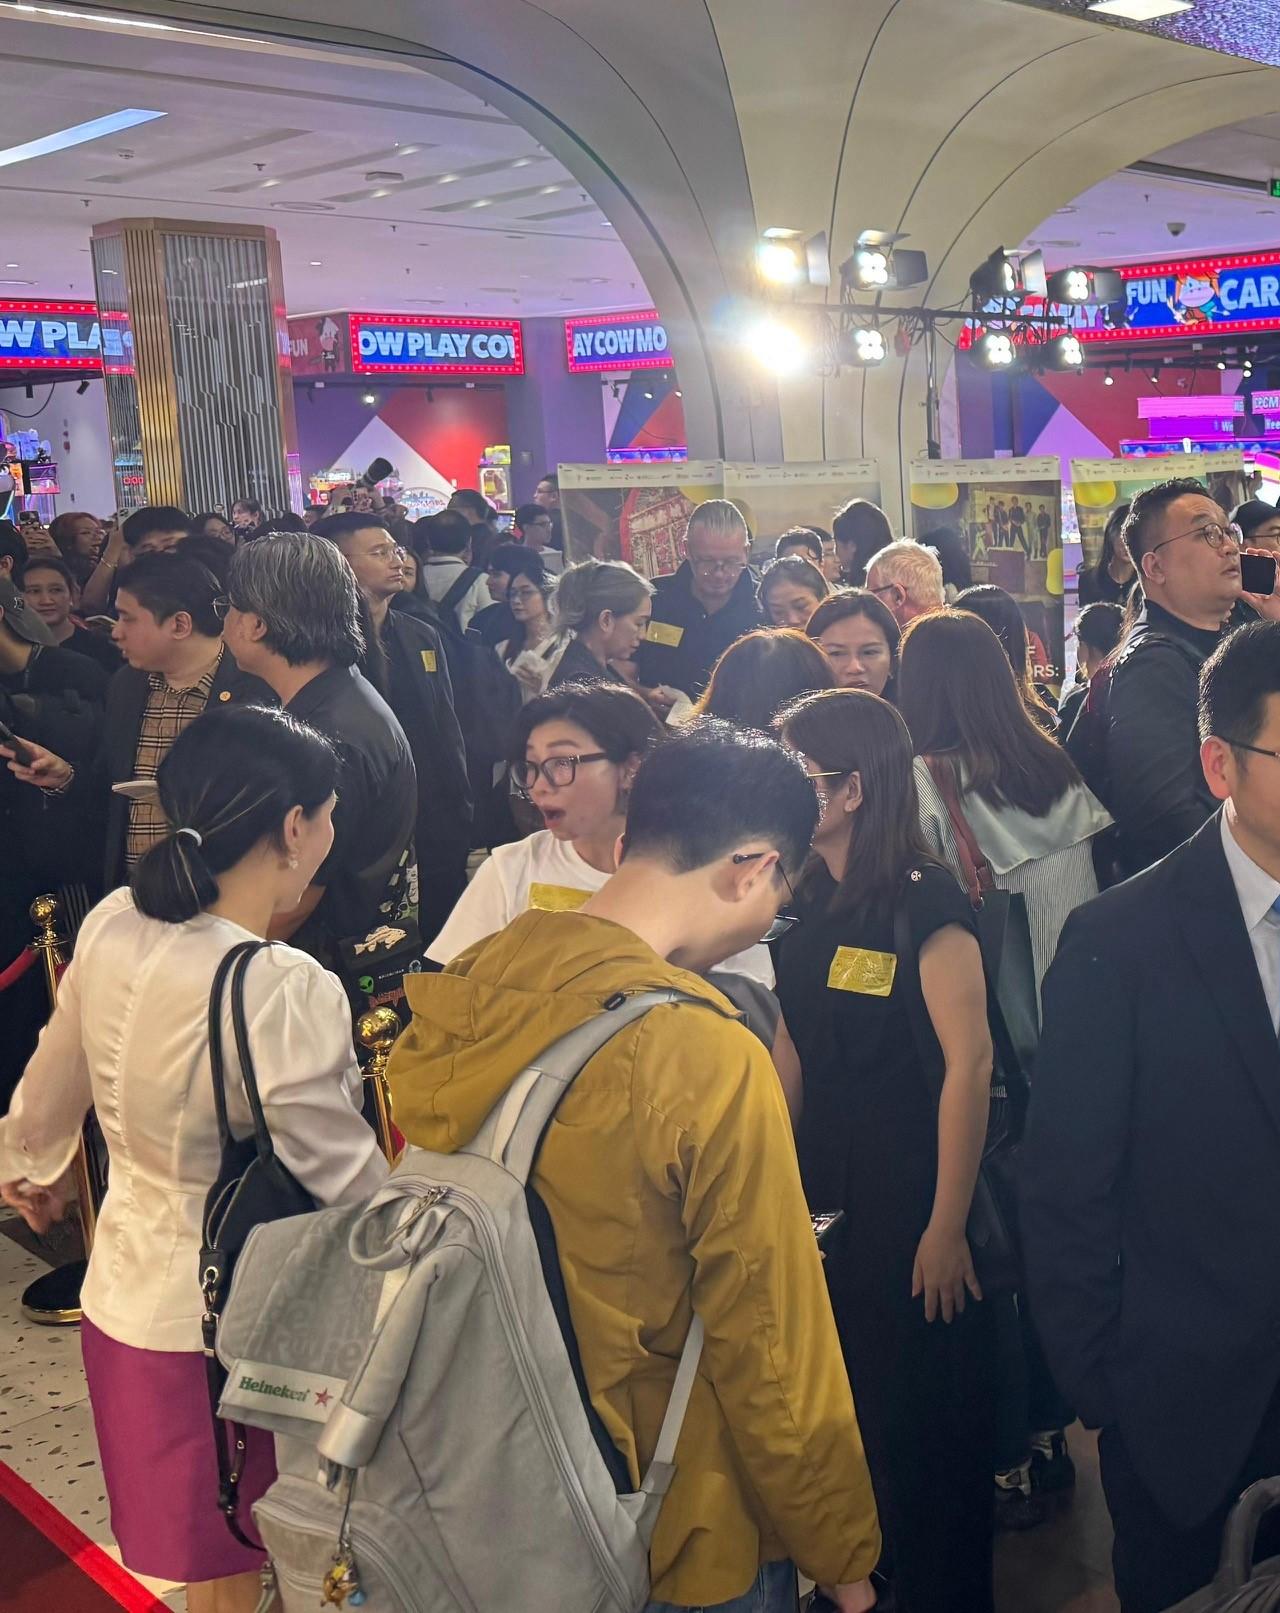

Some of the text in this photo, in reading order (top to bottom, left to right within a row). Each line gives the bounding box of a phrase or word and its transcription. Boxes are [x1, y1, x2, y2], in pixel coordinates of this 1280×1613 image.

[1126, 278, 1167, 306] FUN
[408, 332, 470, 358] PLAY
[594, 328, 634, 355] COW
[635, 325, 667, 352] MO
[239, 1376, 310, 1402] Heineken
